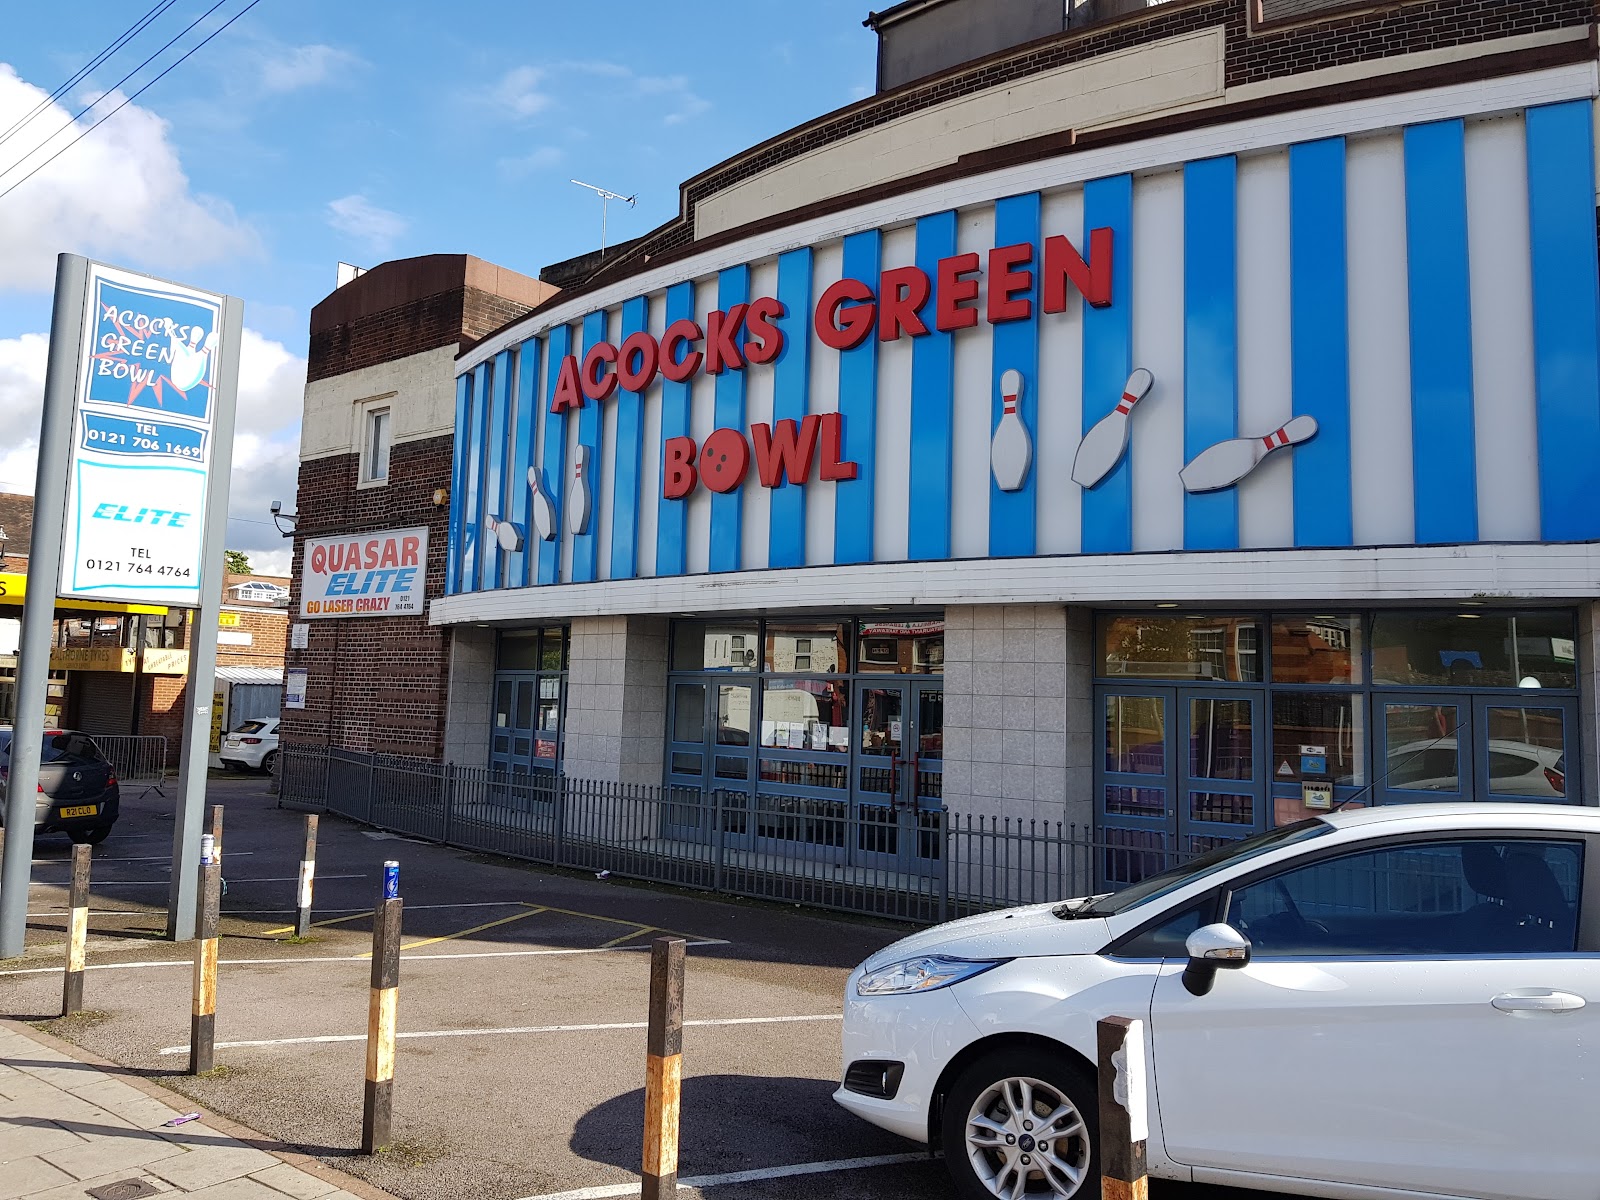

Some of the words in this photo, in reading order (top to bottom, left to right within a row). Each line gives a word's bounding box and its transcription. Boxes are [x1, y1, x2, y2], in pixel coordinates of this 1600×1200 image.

[103, 305, 190, 342] ACOCKS
[550, 296, 784, 414] ACOCKS
[814, 226, 1114, 350] GREEN
[101, 332, 175, 364] GREEN
[98, 357, 157, 387] BOWL
[88, 429, 126, 445] 0121
[132, 436, 160, 451] 706
[165, 442, 201, 457] 1669
[135, 422, 160, 437] TEL
[663, 411, 858, 499] BOWL
[92, 502, 192, 528] ELITE
[130, 547, 152, 559] TEL
[311, 536, 420, 576] QUASAR
[86, 558, 121, 572] 0121
[127, 562, 153, 575] 764
[157, 565, 191, 578] 4764
[325, 567, 418, 596] ELITE
[307, 600, 320, 613] GO
[323, 599, 353, 613] LASER
[356, 596, 390, 612] CRAZY
